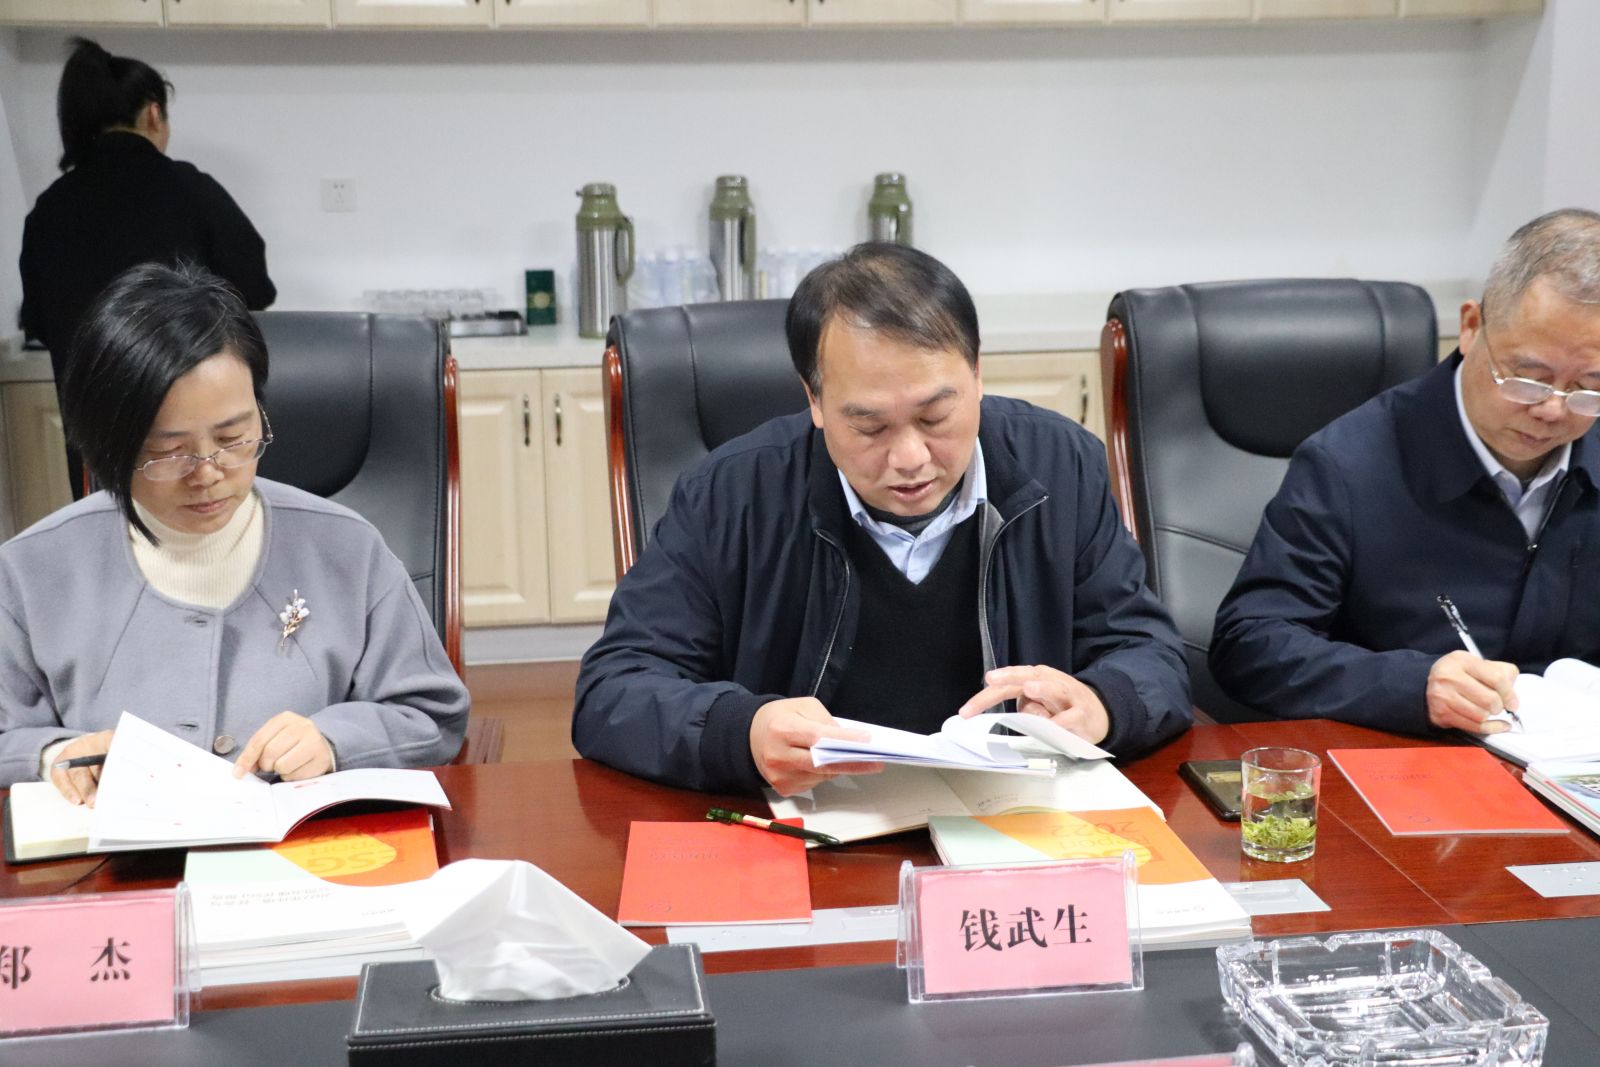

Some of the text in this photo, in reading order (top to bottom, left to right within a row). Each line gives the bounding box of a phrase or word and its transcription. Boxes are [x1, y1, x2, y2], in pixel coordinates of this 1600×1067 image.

[959, 904, 1092, 952] 钱武生
[90, 937, 132, 982] 杰
